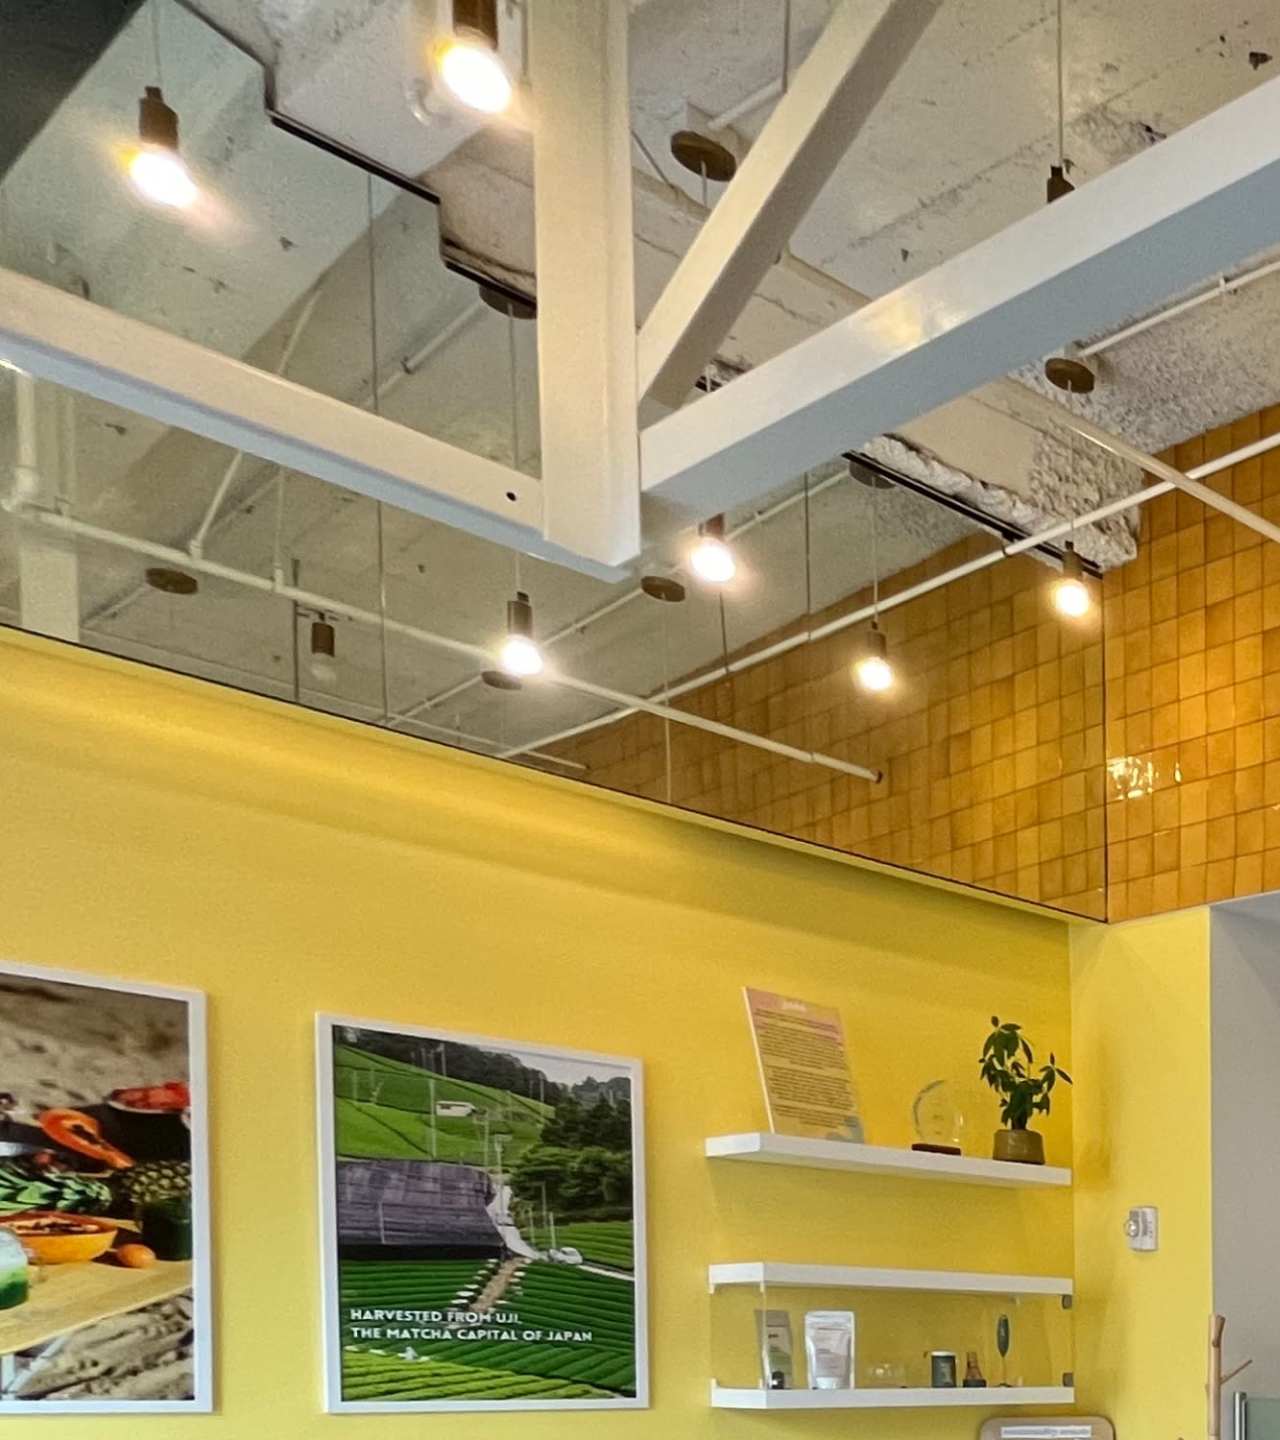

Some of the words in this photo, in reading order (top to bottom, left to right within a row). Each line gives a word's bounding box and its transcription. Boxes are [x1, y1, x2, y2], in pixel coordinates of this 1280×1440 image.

[350, 1309, 442, 1322] HARVESTED
[447, 1311, 491, 1323] FROM
[351, 1327, 381, 1338] THE
[386, 1328, 452, 1339] MATCHA
[457, 1329, 518, 1340] CAPITAL
[522, 1330, 543, 1341] OF
[548, 1331, 592, 1342] JAPAN
